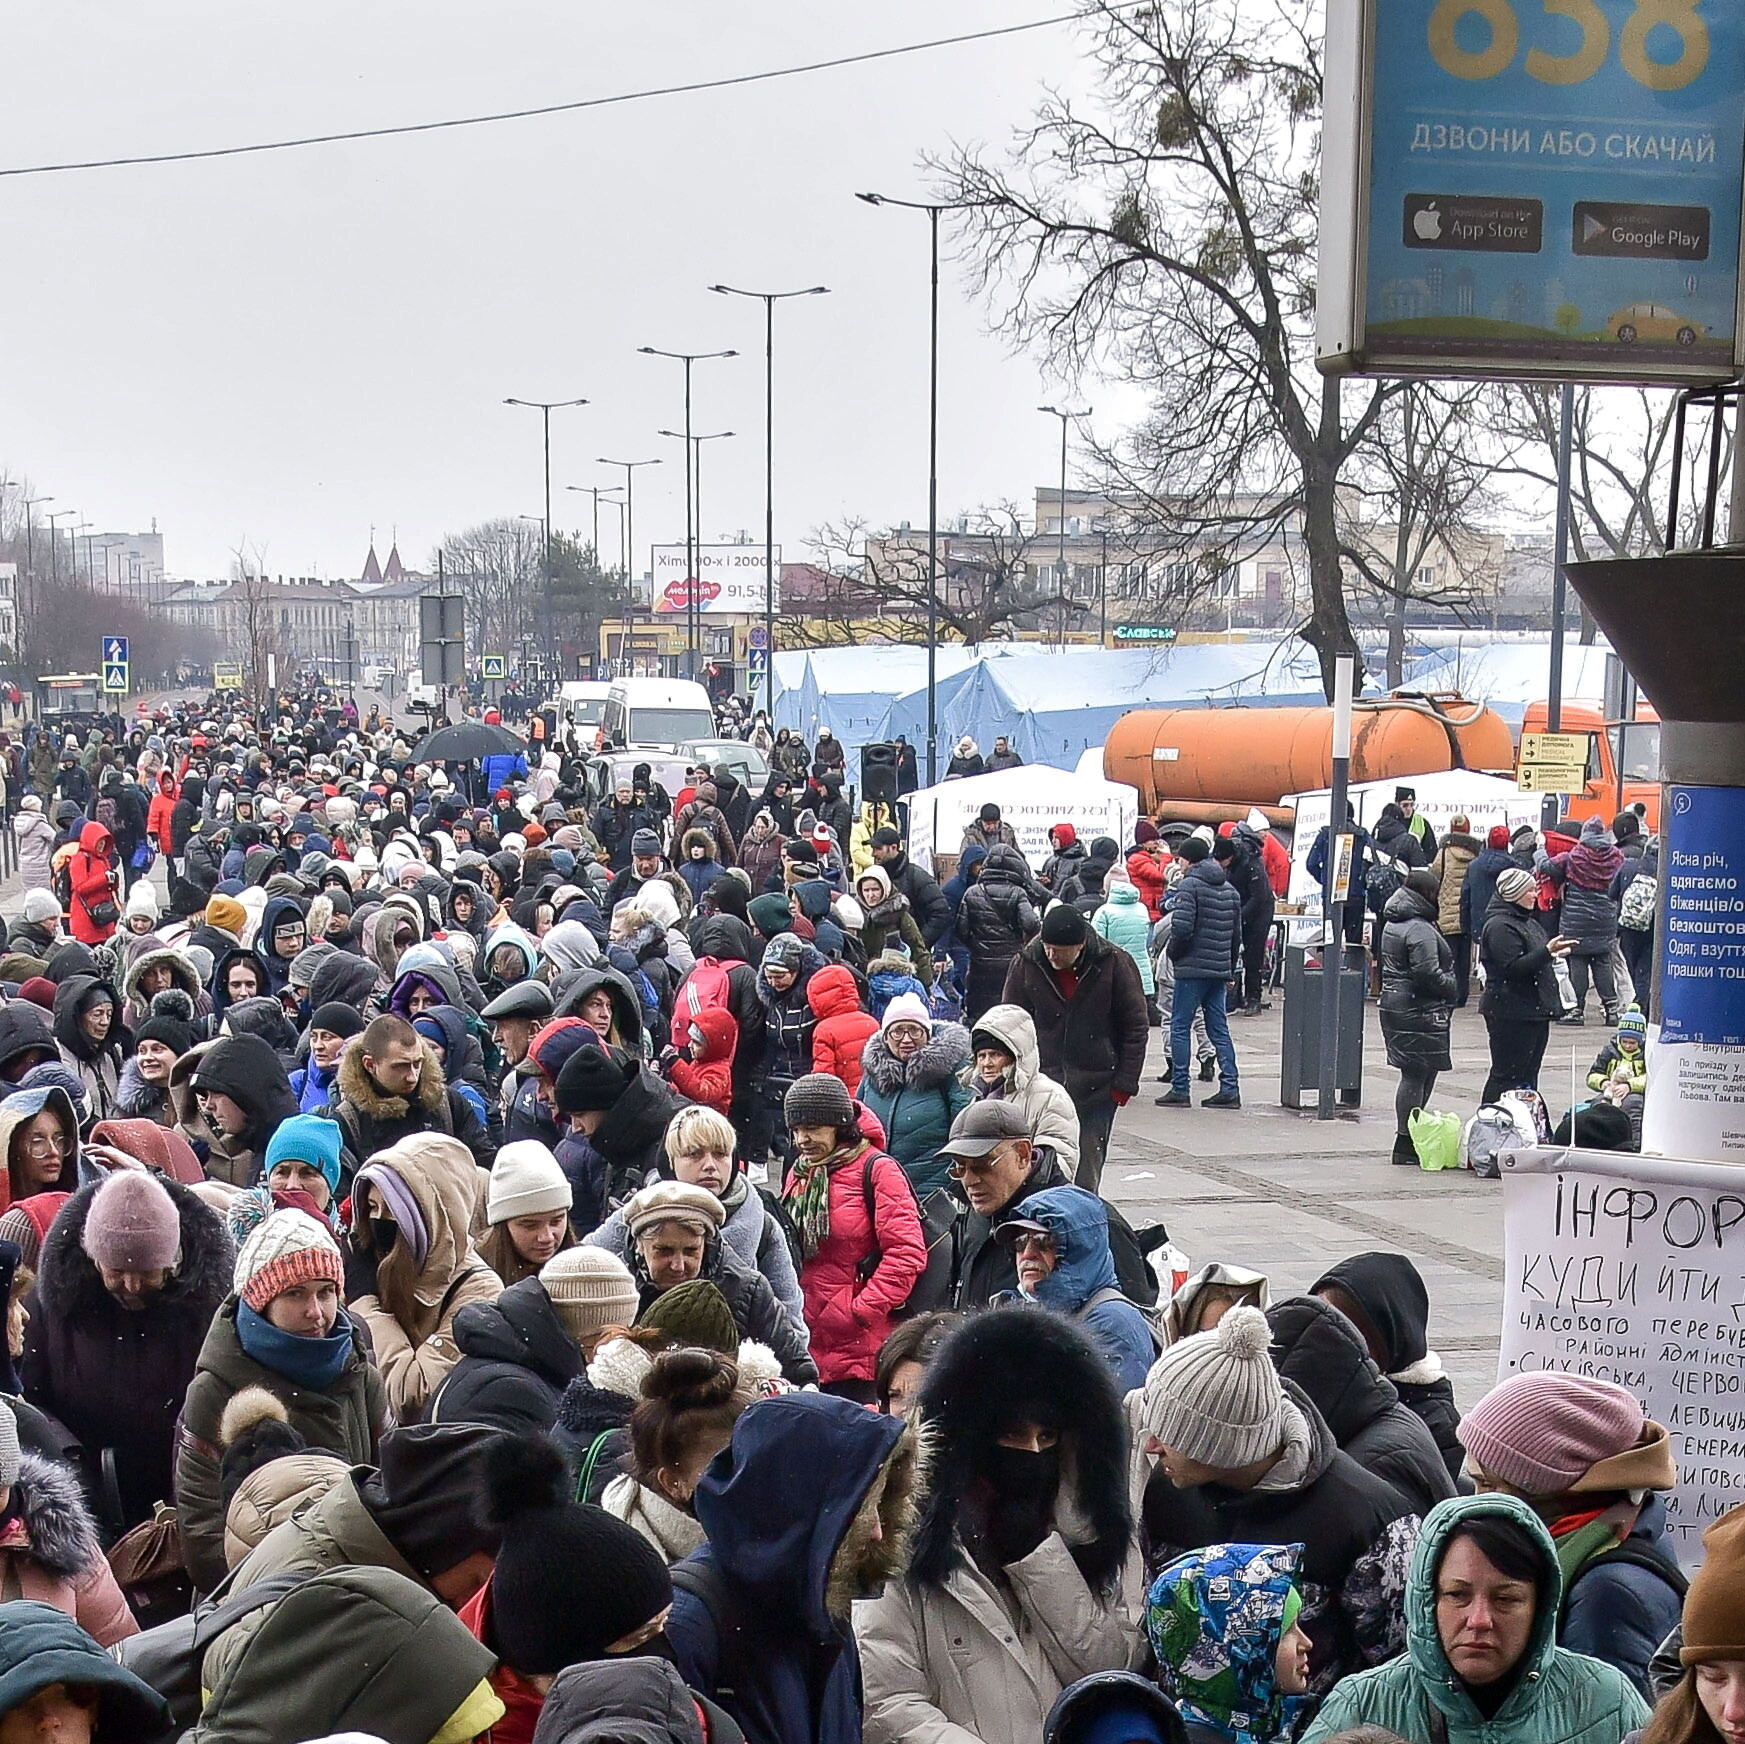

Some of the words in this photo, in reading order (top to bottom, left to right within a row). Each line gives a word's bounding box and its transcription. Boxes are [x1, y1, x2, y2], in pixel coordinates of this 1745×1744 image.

[1410, 123, 1530, 153] ДЗВОНИ
[1538, 129, 1597, 157] АБО
[1605, 133, 1716, 163] СКАЧАЙ
[1451, 220, 1484, 239] App
[1488, 221, 1528, 239] Store
[1612, 227, 1664, 247] Google
[1668, 231, 1700, 249] Play
[1671, 851, 1699, 866] Ясна
[1703, 852, 1728, 870] річ,
[1671, 876, 1737, 890] вдягаємо
[1668, 938, 1696, 957] Одяг,
[1667, 960, 1713, 979] іграшки
[1679, 1058, 1690, 1067] По
[1734, 1063, 1740, 1072] у
[1713, 1093, 1731, 1102] Там
[1521, 1254, 1638, 1313] КУДИ
[1657, 1255, 1722, 1304] ЙТИ
